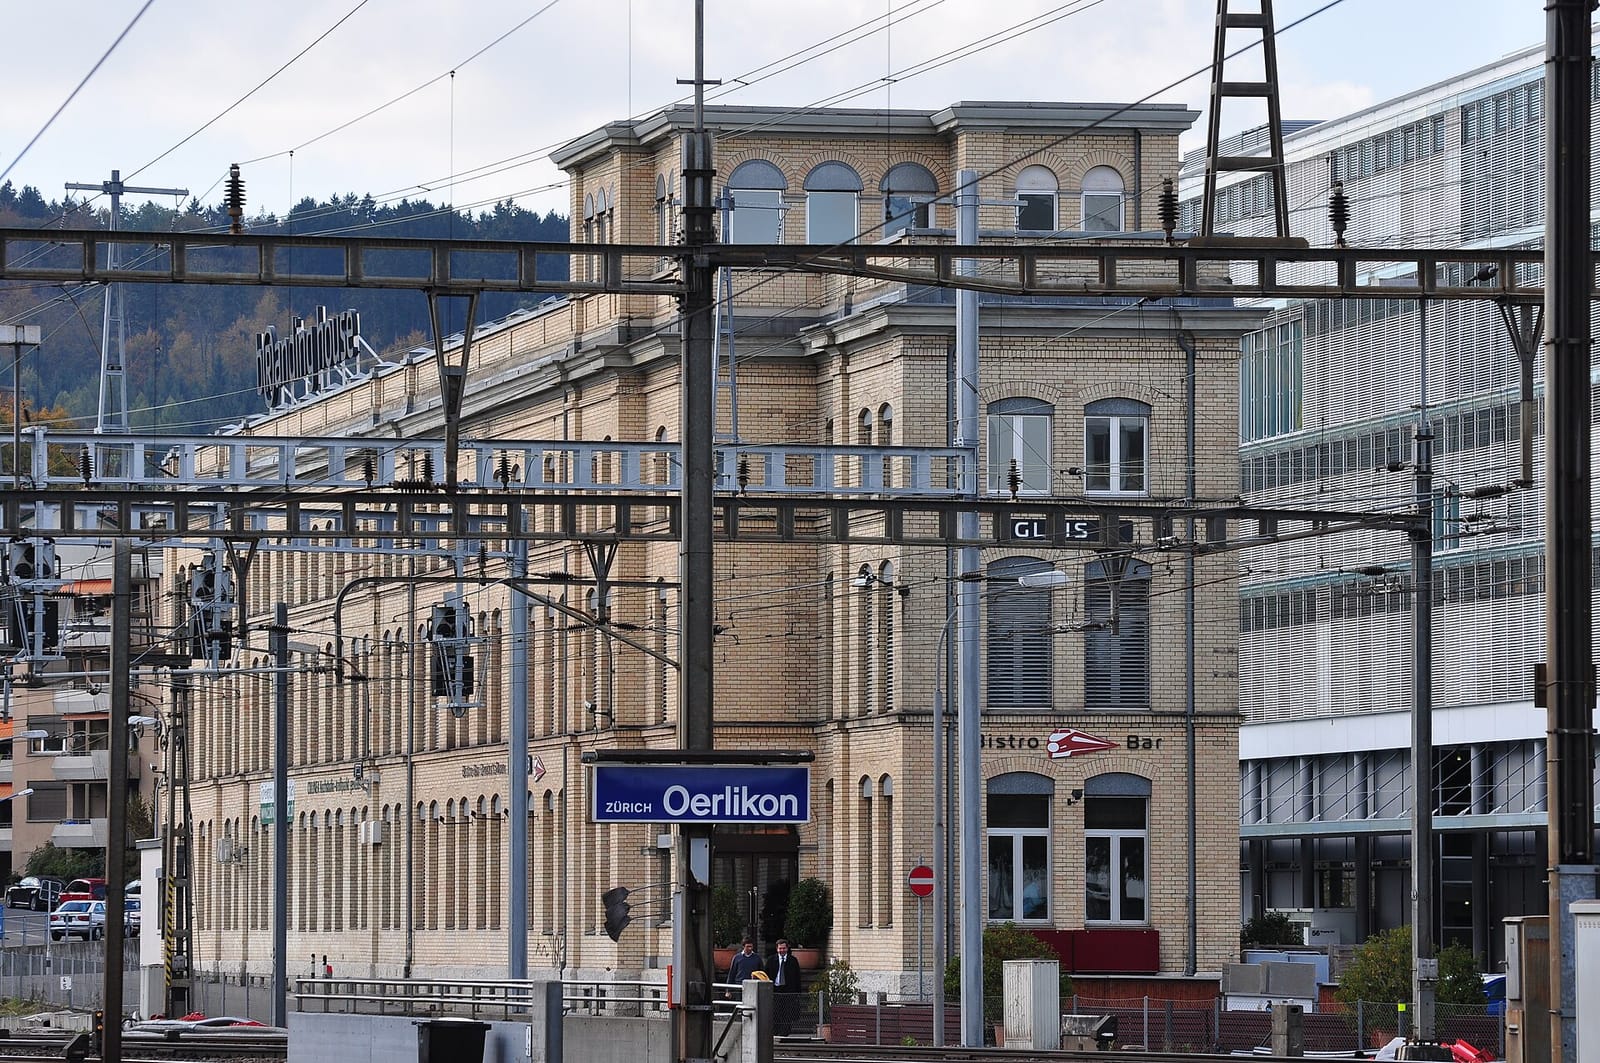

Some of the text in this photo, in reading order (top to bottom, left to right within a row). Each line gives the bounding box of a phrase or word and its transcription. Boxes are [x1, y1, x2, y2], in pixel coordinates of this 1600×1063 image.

[316, 305, 360, 370] house
[1014, 522, 1088, 539] GLIS
[1126, 734, 1163, 750] Bar
[605, 784, 798, 817] ZÜRICH Oerlikon
